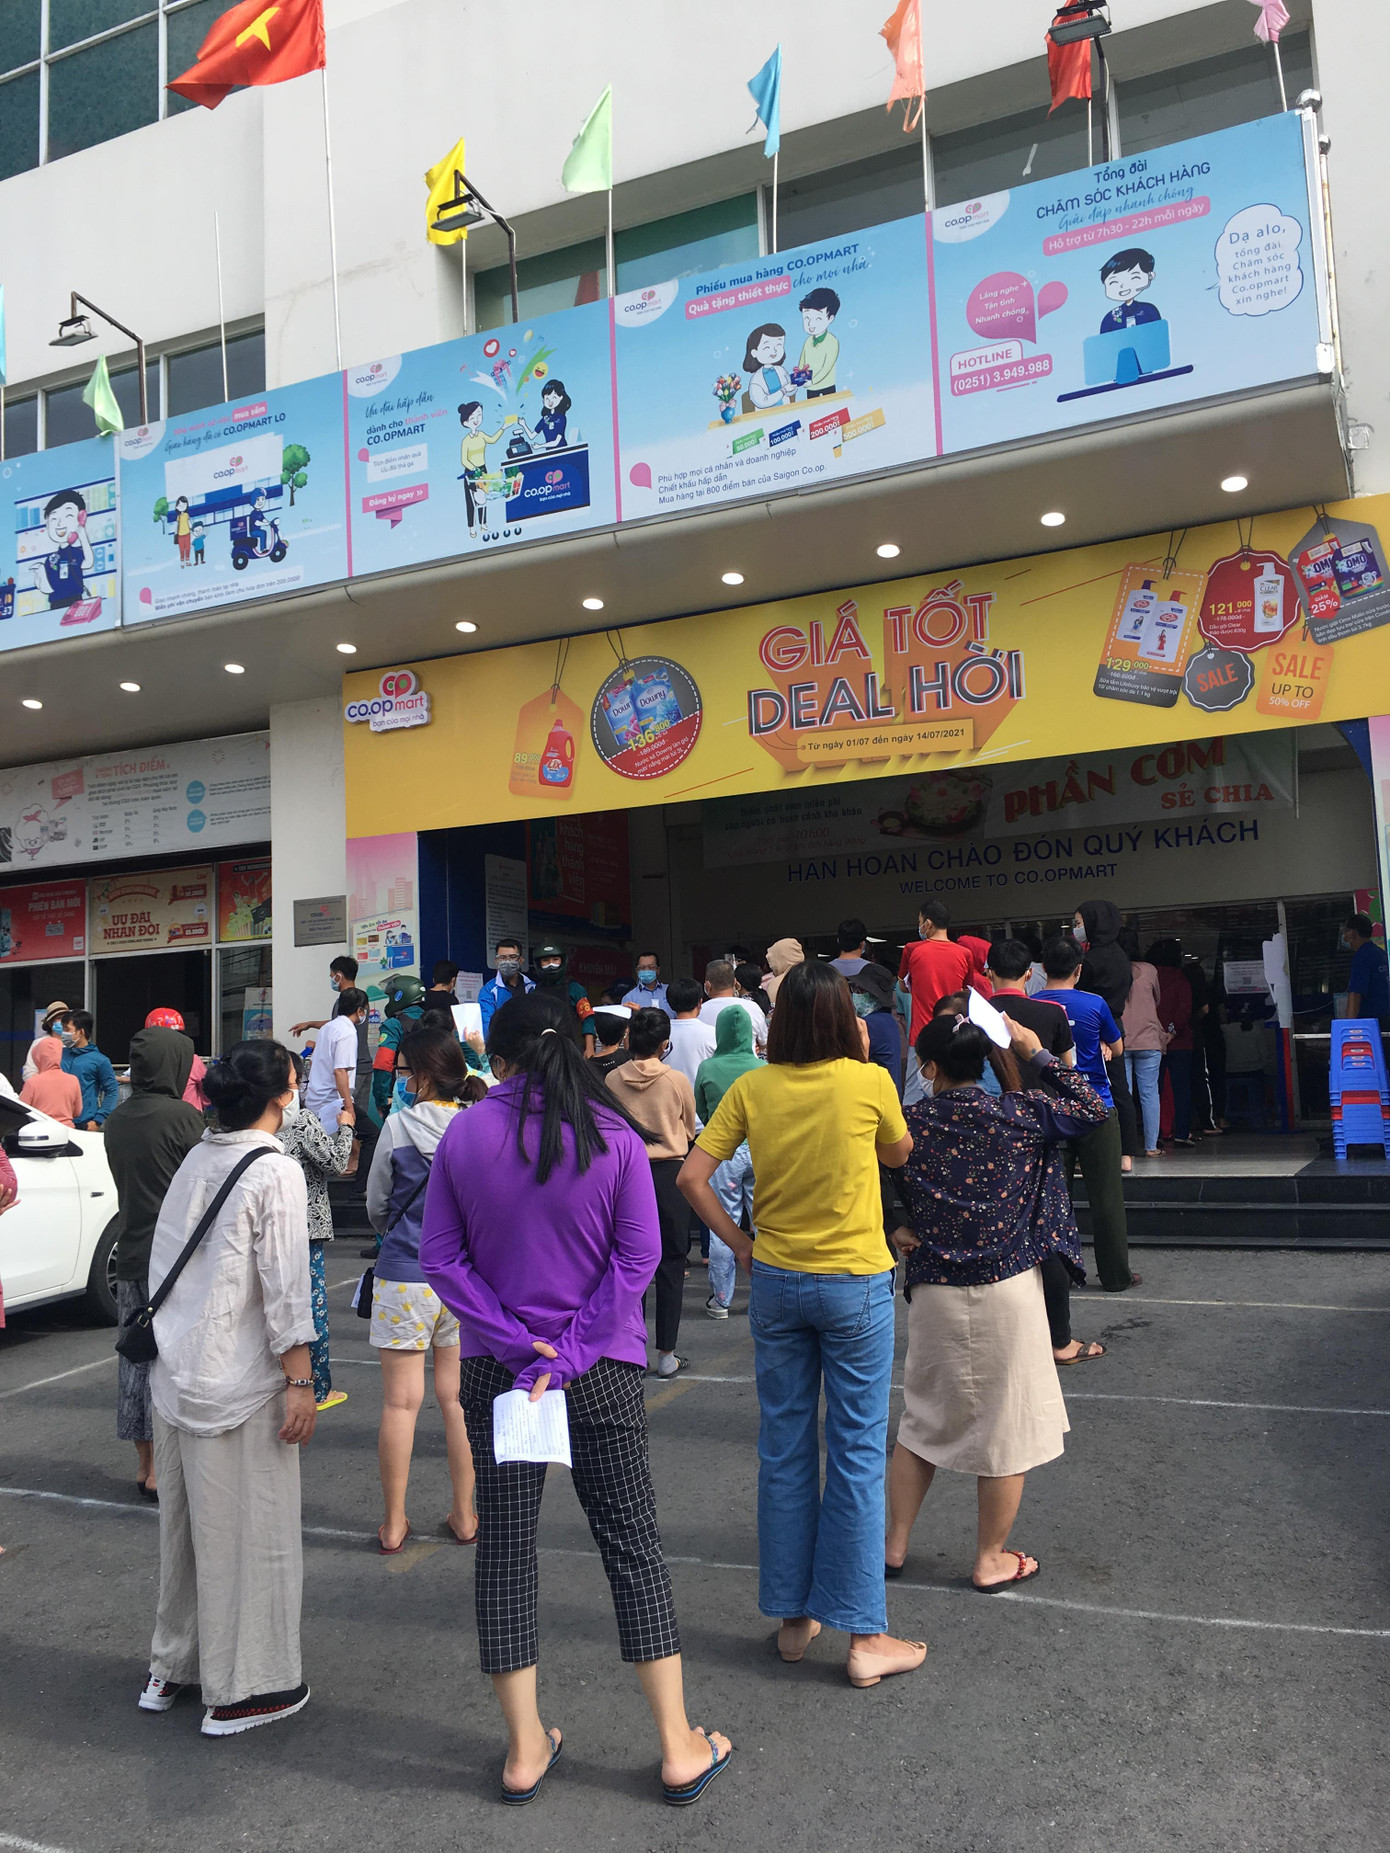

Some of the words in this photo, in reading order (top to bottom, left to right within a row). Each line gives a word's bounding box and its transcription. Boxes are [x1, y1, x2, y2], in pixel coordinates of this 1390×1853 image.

[1094, 166, 1125, 184] Tổng
[1128, 159, 1148, 177] đài
[1036, 200, 1080, 219] CHĂM
[1085, 187, 1112, 204] SÓC
[1116, 174, 1166, 197] KHÁCH
[1169, 161, 1211, 183] HÀNG
[1087, 206, 1113, 224] đáp
[1115, 195, 1155, 215] nhanh
[1157, 184, 1196, 203] chóng
[944, 211, 990, 228] co.opmart
[1049, 237, 1064, 251] Hỗ
[1066, 233, 1081, 247] trợ
[1083, 227, 1096, 241] từ
[1097, 222, 1123, 238] 7h30
[1131, 217, 1152, 231] 22h
[1154, 211, 1176, 226] mỗi
[1178, 203, 1205, 220] ngày
[1229, 230, 1250, 246] Dạ
[1256, 222, 1286, 240] alo,
[1264, 241, 1282, 252] đài
[1266, 252, 1285, 263] sóc
[696, 280, 726, 296] Phiếu
[729, 276, 753, 287] mua
[755, 265, 784, 281] hàng
[786, 243, 860, 272] CO.OPMART
[792, 273, 814, 290] cho
[815, 266, 841, 284] mọi
[842, 256, 870, 275] nhà
[1228, 269, 1260, 284] khách
[1263, 262, 1292, 277] hàng
[999, 285, 1019, 296] nghe
[1231, 274, 1290, 295] Co.opmart
[1235, 295, 1252, 306] xin
[1256, 285, 1288, 303] nghe!
[624, 298, 662, 313] co.opmart
[688, 298, 710, 316] Quà
[711, 292, 736, 310] tặng
[738, 286, 763, 303] thiết
[765, 279, 789, 297] thực
[984, 302, 999, 311] Tận
[1000, 298, 1015, 307] tình
[975, 313, 1001, 325] Nhanh
[1002, 306, 1026, 319] chóng
[958, 348, 1013, 371] HOTLINE
[954, 373, 991, 394] (0251)
[993, 359, 1050, 382] 3.949.988
[223, 416, 273, 437] CO.OPMART
[275, 412, 286, 423] LO
[366, 423, 387, 435] dành
[388, 419, 404, 430] cho
[366, 423, 426, 446] CO.OPMART
[658, 474, 673, 484] Phù
[674, 470, 688, 482] hợp
[689, 467, 703, 480] mọi
[704, 464, 714, 474] cá
[714, 460, 734, 472] nhân
[735, 458, 745, 467] và
[745, 452, 769, 466] doanh
[770, 447, 797, 462] nghiệp
[524, 481, 571, 498] co.opmart
[658, 483, 678, 495] Chiết
[678, 478, 697, 491] khấu
[698, 475, 713, 490] hấp
[713, 472, 728, 484] dẫn
[658, 495, 675, 505] Mua
[675, 491, 694, 504] hàng
[696, 488, 706, 498] tại
[706, 485, 721, 495] 800
[722, 480, 741, 492] điểm
[742, 477, 756, 488] bán
[757, 475, 772, 486] của
[773, 469, 800, 482] Saigon
[801, 464, 828, 478] Co.op.
[388, 493, 397, 503] ký
[398, 490, 415, 501] ngay
[1346, 555, 1366, 569] OMO
[1311, 598, 1338, 614] 25%
[759, 599, 872, 673] GIÁ
[884, 578, 997, 656] TỐT
[1272, 652, 1325, 680] SALE
[748, 672, 896, 736] DEAL
[910, 640, 1026, 714] HỜI
[1196, 663, 1238, 693] SALE
[639, 689, 667, 708] Downy
[1269, 696, 1290, 707] 50%
[1291, 699, 1311, 709] OFF
[1272, 683, 1291, 696] UP
[1295, 685, 1314, 699] TO
[347, 695, 424, 719] co.opmart
[612, 700, 632, 717] Down
[373, 719, 386, 728] bạn
[412, 712, 425, 721] nhà
[808, 740, 821, 751] Từ
[822, 738, 844, 751] ngày
[846, 736, 870, 748] 01/07
[872, 732, 890, 745] đến
[892, 732, 914, 744] ngày
[916, 728, 965, 741] 14/07/2021
[112, 761, 137, 777] TÍCH
[139, 756, 166, 775] ĐIỂM
[514, 752, 528, 764] 89
[1004, 759, 1117, 824] PHẦN
[1131, 736, 1227, 787] CƠM
[1160, 783, 1197, 810] SẺ
[1203, 783, 1276, 804] CHIA
[788, 857, 838, 884] HÂN
[847, 853, 918, 879] HOAN
[928, 843, 1002, 871] CHÀO
[1014, 834, 1073, 862] ĐÓN
[1084, 825, 1144, 857] QUÝ
[1154, 819, 1259, 849] KHÁCH
[899, 876, 982, 895] WELCOME
[987, 873, 1007, 887] TO
[1014, 863, 1118, 886] CO.OPMART
